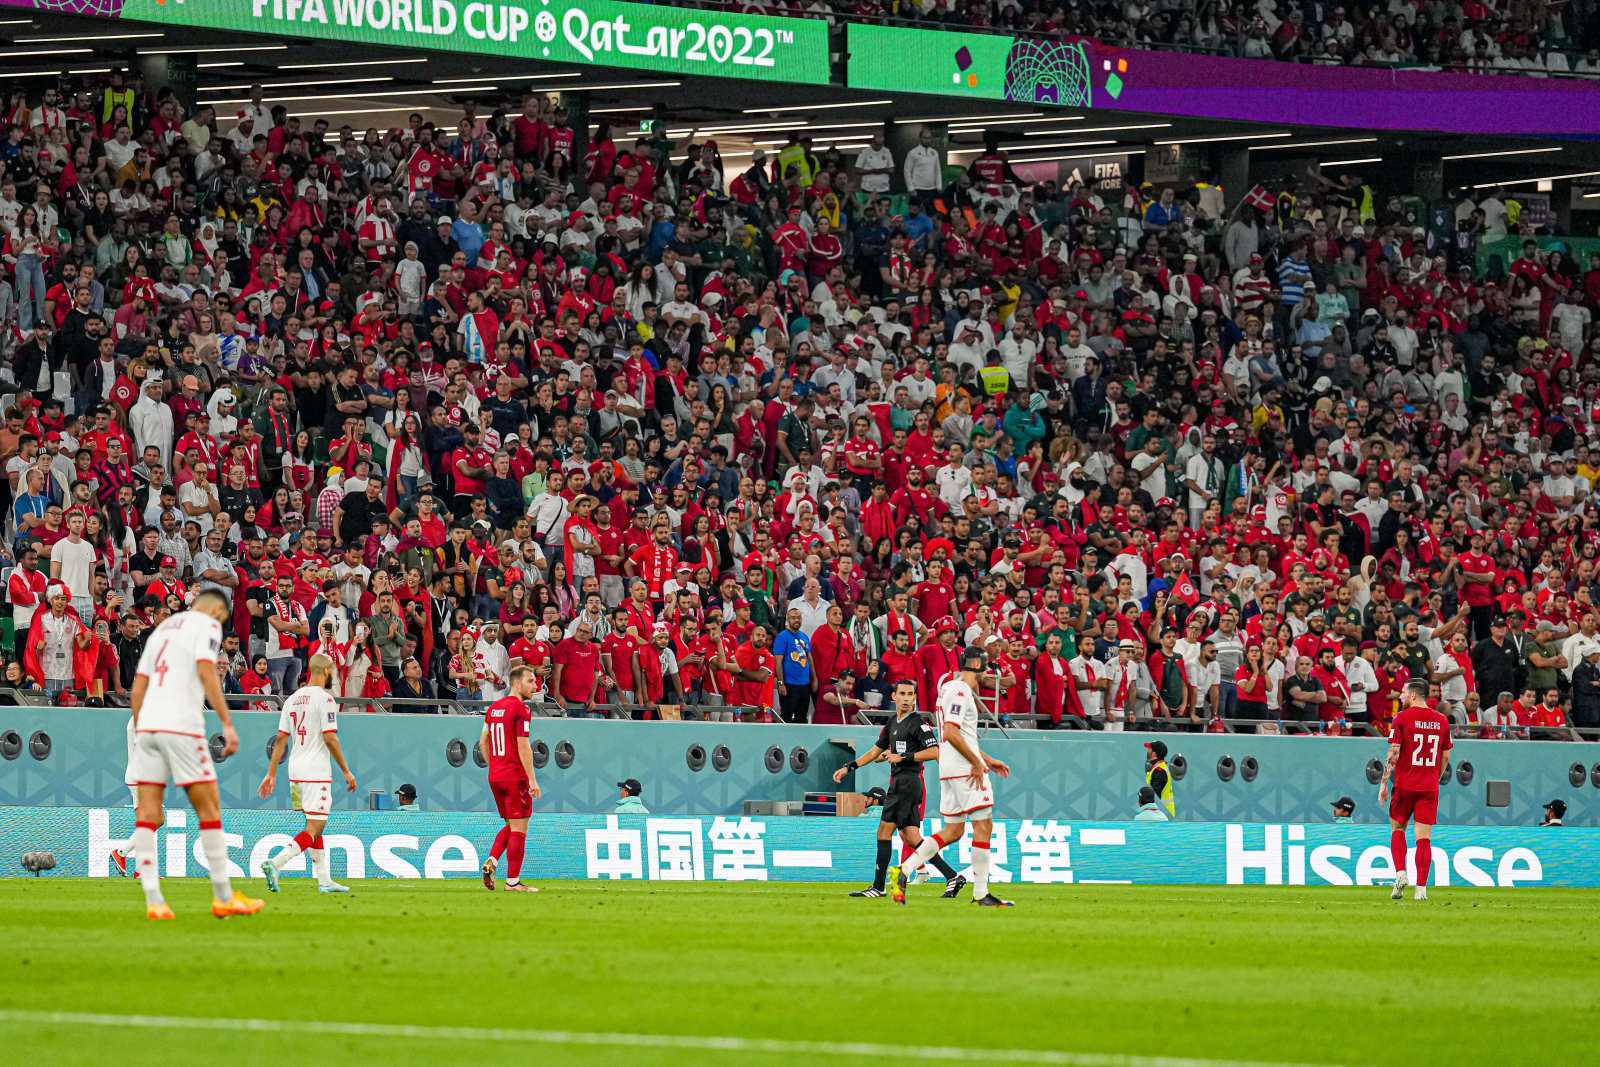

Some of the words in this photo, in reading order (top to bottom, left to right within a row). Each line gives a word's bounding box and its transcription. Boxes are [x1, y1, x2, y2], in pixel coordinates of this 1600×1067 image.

[331, 0, 457, 35] WORLD
[463, 2, 529, 42] CUP
[168, 69, 187, 80] EXIT
[1094, 162, 1121, 179] FIFA
[1099, 178, 1121, 190] TORE
[154, 640, 168, 687] 4
[289, 711, 306, 746] 14
[490, 722, 506, 757] 10
[1411, 733, 1440, 767] 23
[87, 808, 480, 879] Hisense
[584, 814, 833, 880] 中国第一
[1225, 823, 1543, 887] Hisense
